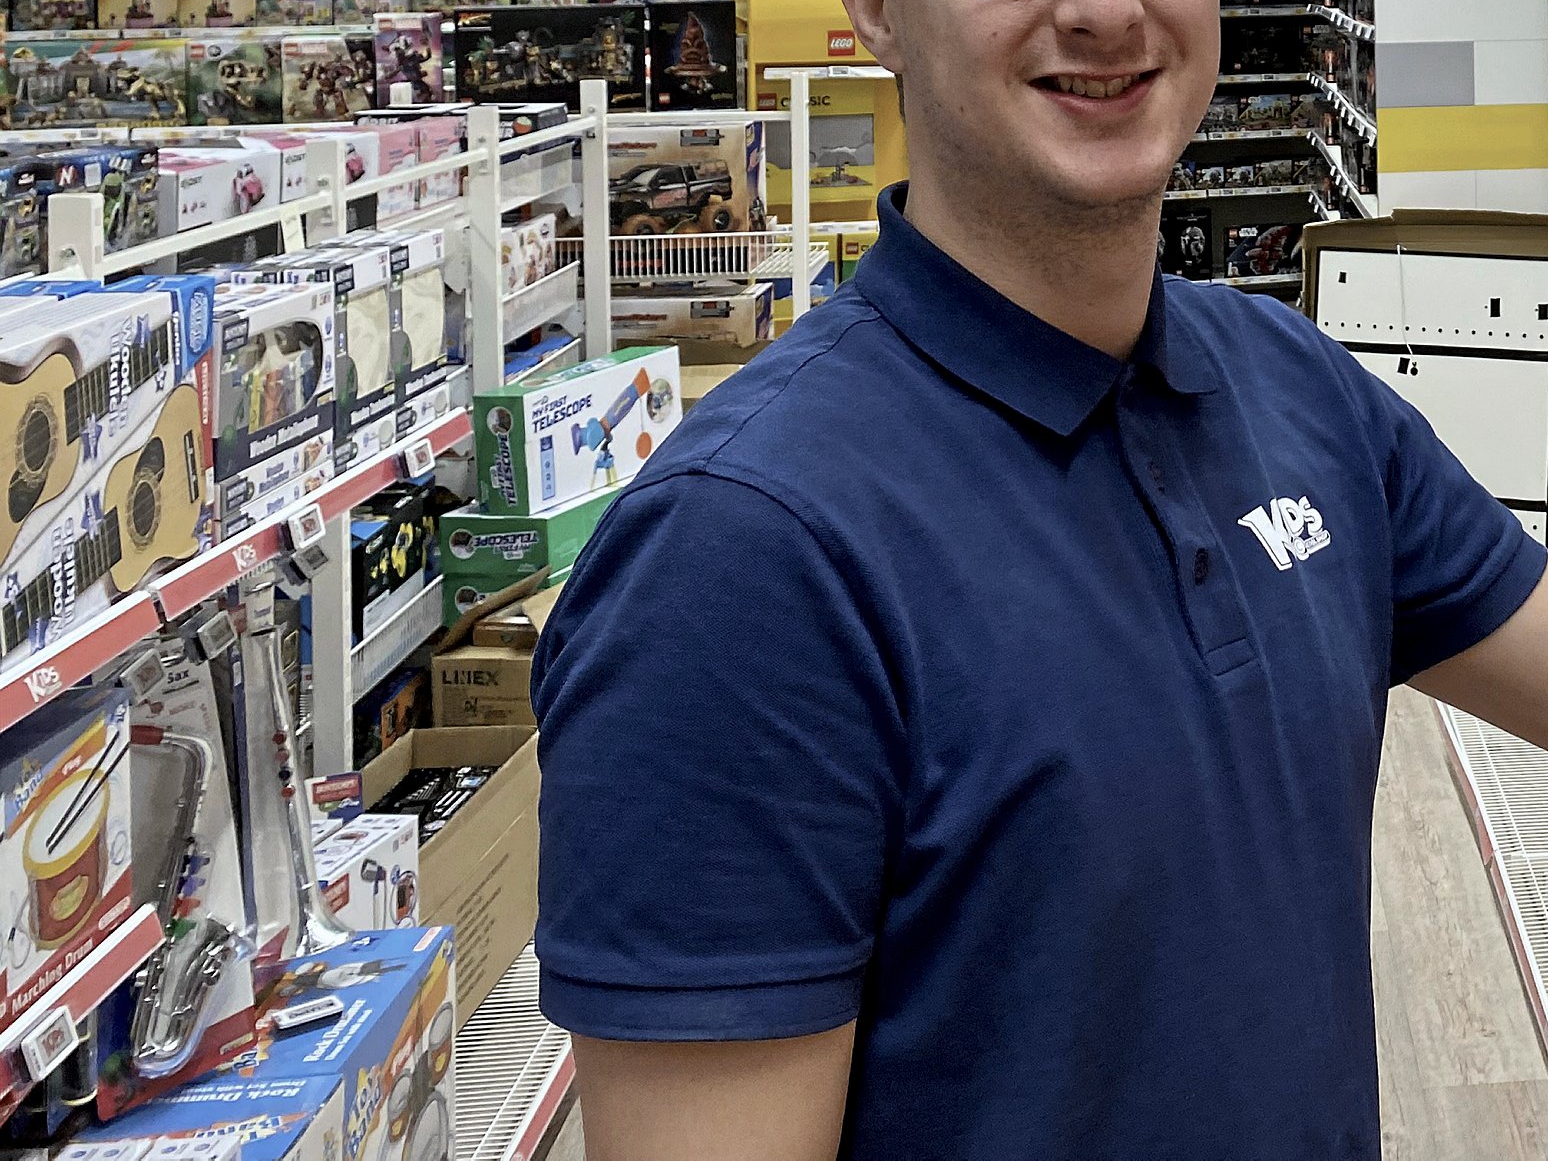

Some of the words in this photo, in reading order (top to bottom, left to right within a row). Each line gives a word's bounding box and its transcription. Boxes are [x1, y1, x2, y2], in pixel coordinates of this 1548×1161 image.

[831, 38, 854, 50] LEGO
[781, 95, 831, 108] CSIC
[532, 394, 592, 434] TELESCOPE
[166, 667, 190, 684] Sax
[12, 963, 63, 1016] Marching
[64, 938, 94, 970] Drum
